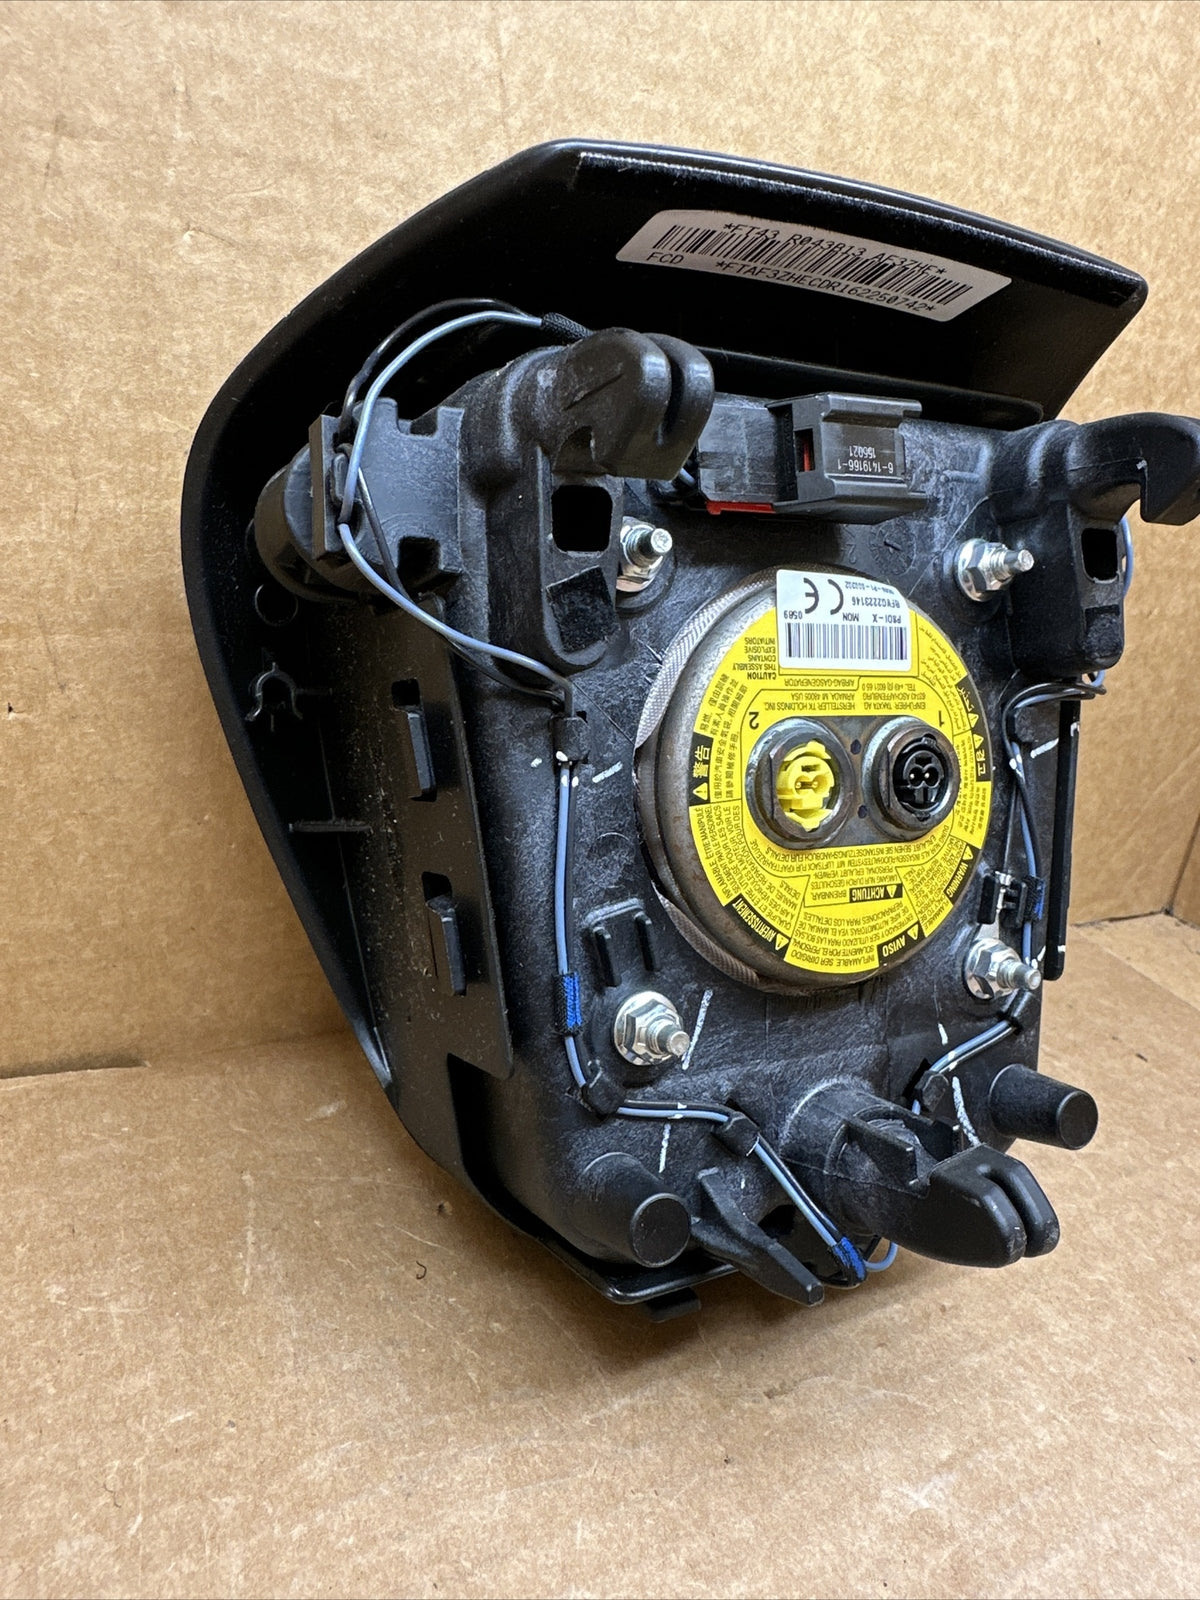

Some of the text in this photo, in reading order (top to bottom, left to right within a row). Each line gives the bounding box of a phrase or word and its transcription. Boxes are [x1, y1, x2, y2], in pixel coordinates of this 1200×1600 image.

[646, 252, 685, 265] FCD
[837, 459, 894, 474] 6-1419166-1
[744, 645, 775, 653] EXPLOSIVE
[747, 671, 777, 680] CAUTION
[784, 679, 855, 687] AIRBAG-GASGENERATOR
[863, 692, 909, 700] ASCHAFFENBURG
[777, 702, 808, 710] HOLDINGS
[809, 702, 817, 710] TK
[873, 702, 892, 710] TAKATA
[749, 711, 759, 730] 2
[692, 744, 711, 779] 警告
[713, 806, 724, 826] SACS
[723, 807, 731, 818] LE
[732, 805, 740, 823] DES
[704, 806, 717, 843] PERSONNEL
[725, 818, 734, 836] VOIR
[717, 829, 727, 843] LES
[734, 824, 745, 846] POUR
[722, 844, 734, 864] POUR
[883, 846, 892, 854] SIE
[893, 844, 911, 853] SEHEN
[920, 850, 929, 859] ALS
[749, 839, 795, 874] KRAFTFAHRZEUGE
[807, 861, 834, 872] LUFTSACK
[836, 861, 845, 869] MIT
[866, 866, 893, 876] PERSONAL
[720, 862, 740, 894] SEULEMENT
[810, 874, 897, 890] UMGANG NUR DURCH GESCHULTES
[946, 862, 968, 898] WARNING
[766, 882, 776, 894] DE
[852, 887, 885, 901] ACHTUNG
[775, 890, 797, 910] MANUEL
[862, 901, 903, 925] REPARACIONES
[889, 910, 900, 922] AIRE
[901, 906, 909, 916] DE
[732, 898, 777, 942] AVERTISSEMENT
[798, 920, 806, 930] DE
[833, 919, 845, 927] LOS
[846, 918, 860, 928] PARA
[807, 923, 829, 935] MANUAL
[840, 929, 849, 937] VEA
[794, 929, 816, 942] BOLSAS
[817, 936, 826, 945] LAS
[843, 936, 868, 945] UTILIZADO
[869, 934, 880, 942] SER
[792, 939, 820, 955] PERSONAL
[828, 938, 840, 946] PARA
[882, 935, 906, 957] AVISO
[841, 945, 874, 956] SOLAMENTE
[791, 950, 819, 964] DIRIGIDO
[820, 957, 833, 966] SER
